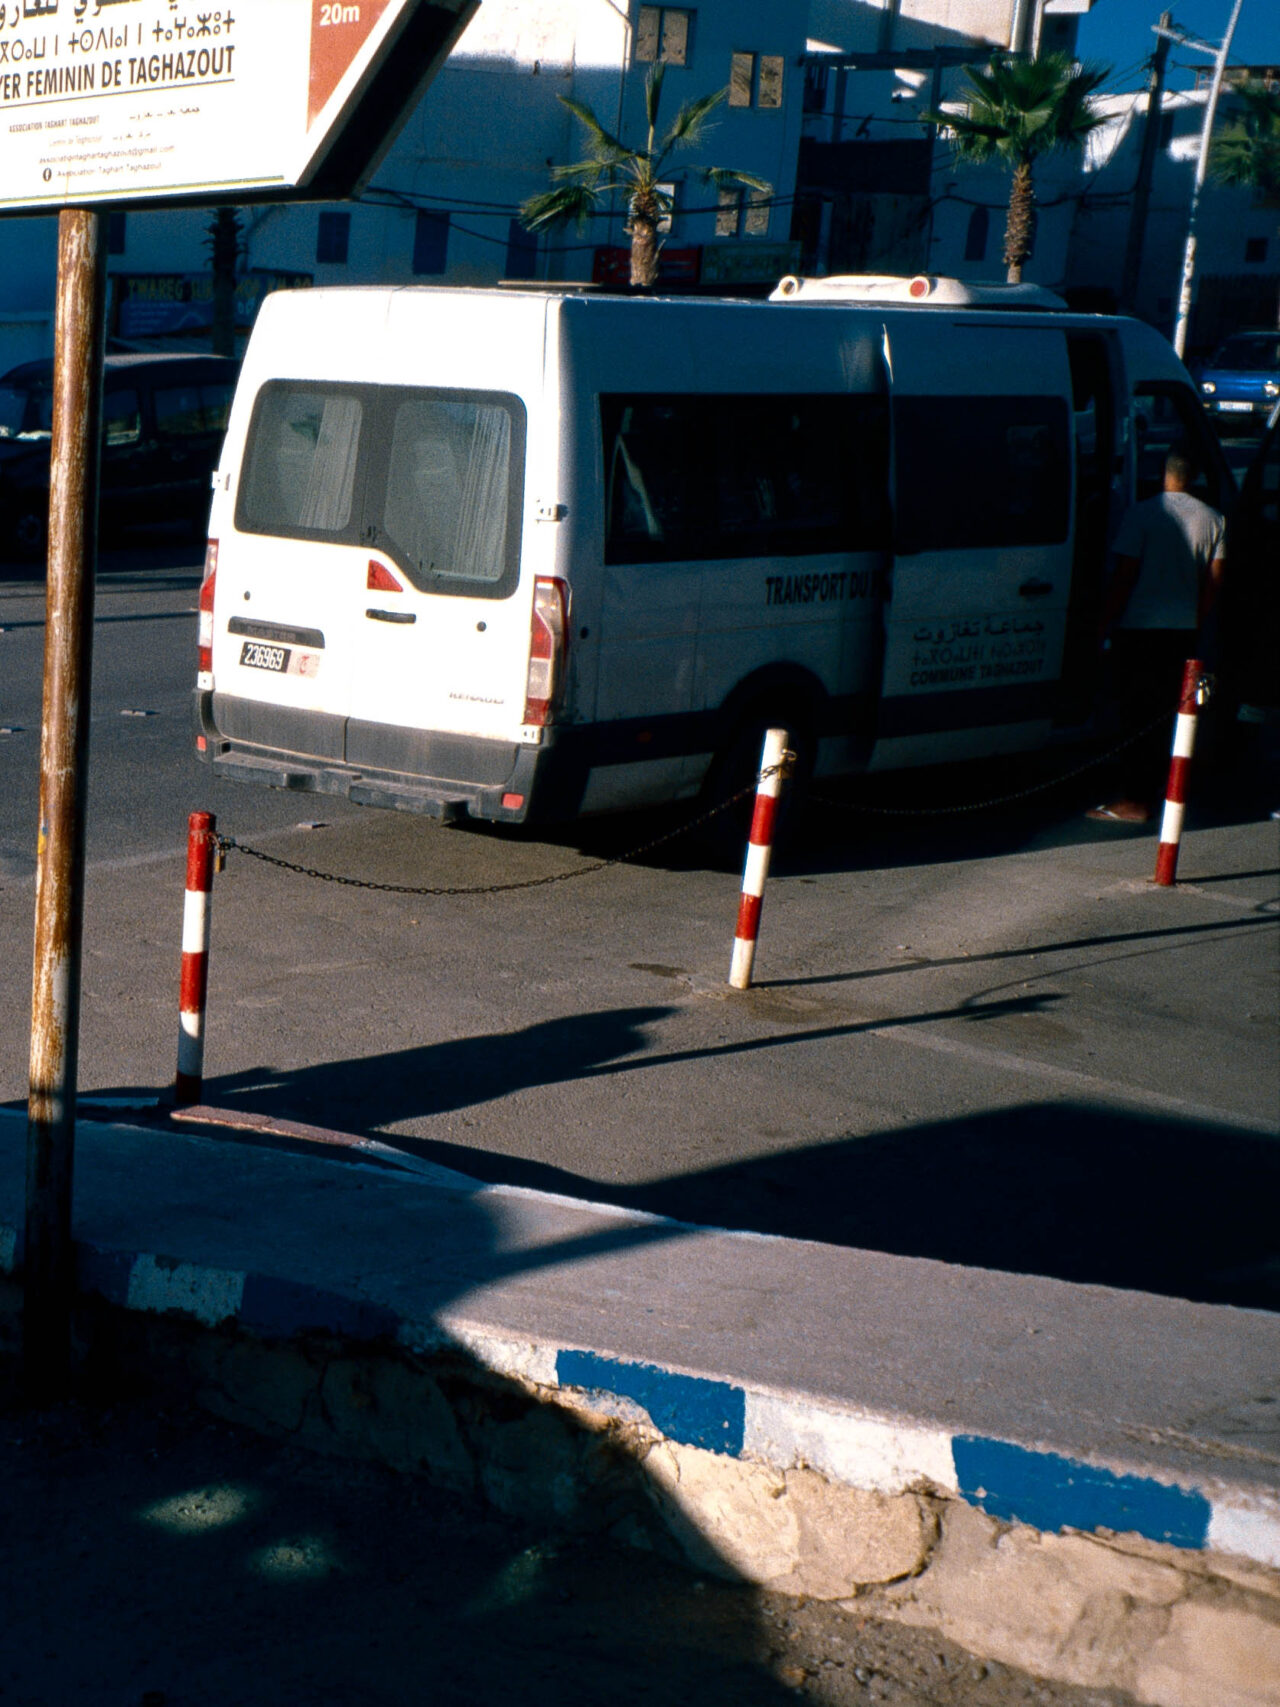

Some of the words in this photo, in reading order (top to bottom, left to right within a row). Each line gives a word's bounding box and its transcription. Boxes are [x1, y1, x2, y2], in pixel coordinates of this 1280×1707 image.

[319, 3, 360, 26] 20m
[26, 63, 95, 97] FEMININ
[101, 59, 122, 88] DE
[128, 45, 236, 84] TAGHAZOUT
[766, 571, 847, 605] TRANSPORT
[850, 570, 869, 600] DU
[244, 643, 285, 671] 236969
[910, 665, 977, 687] COMMUNE
